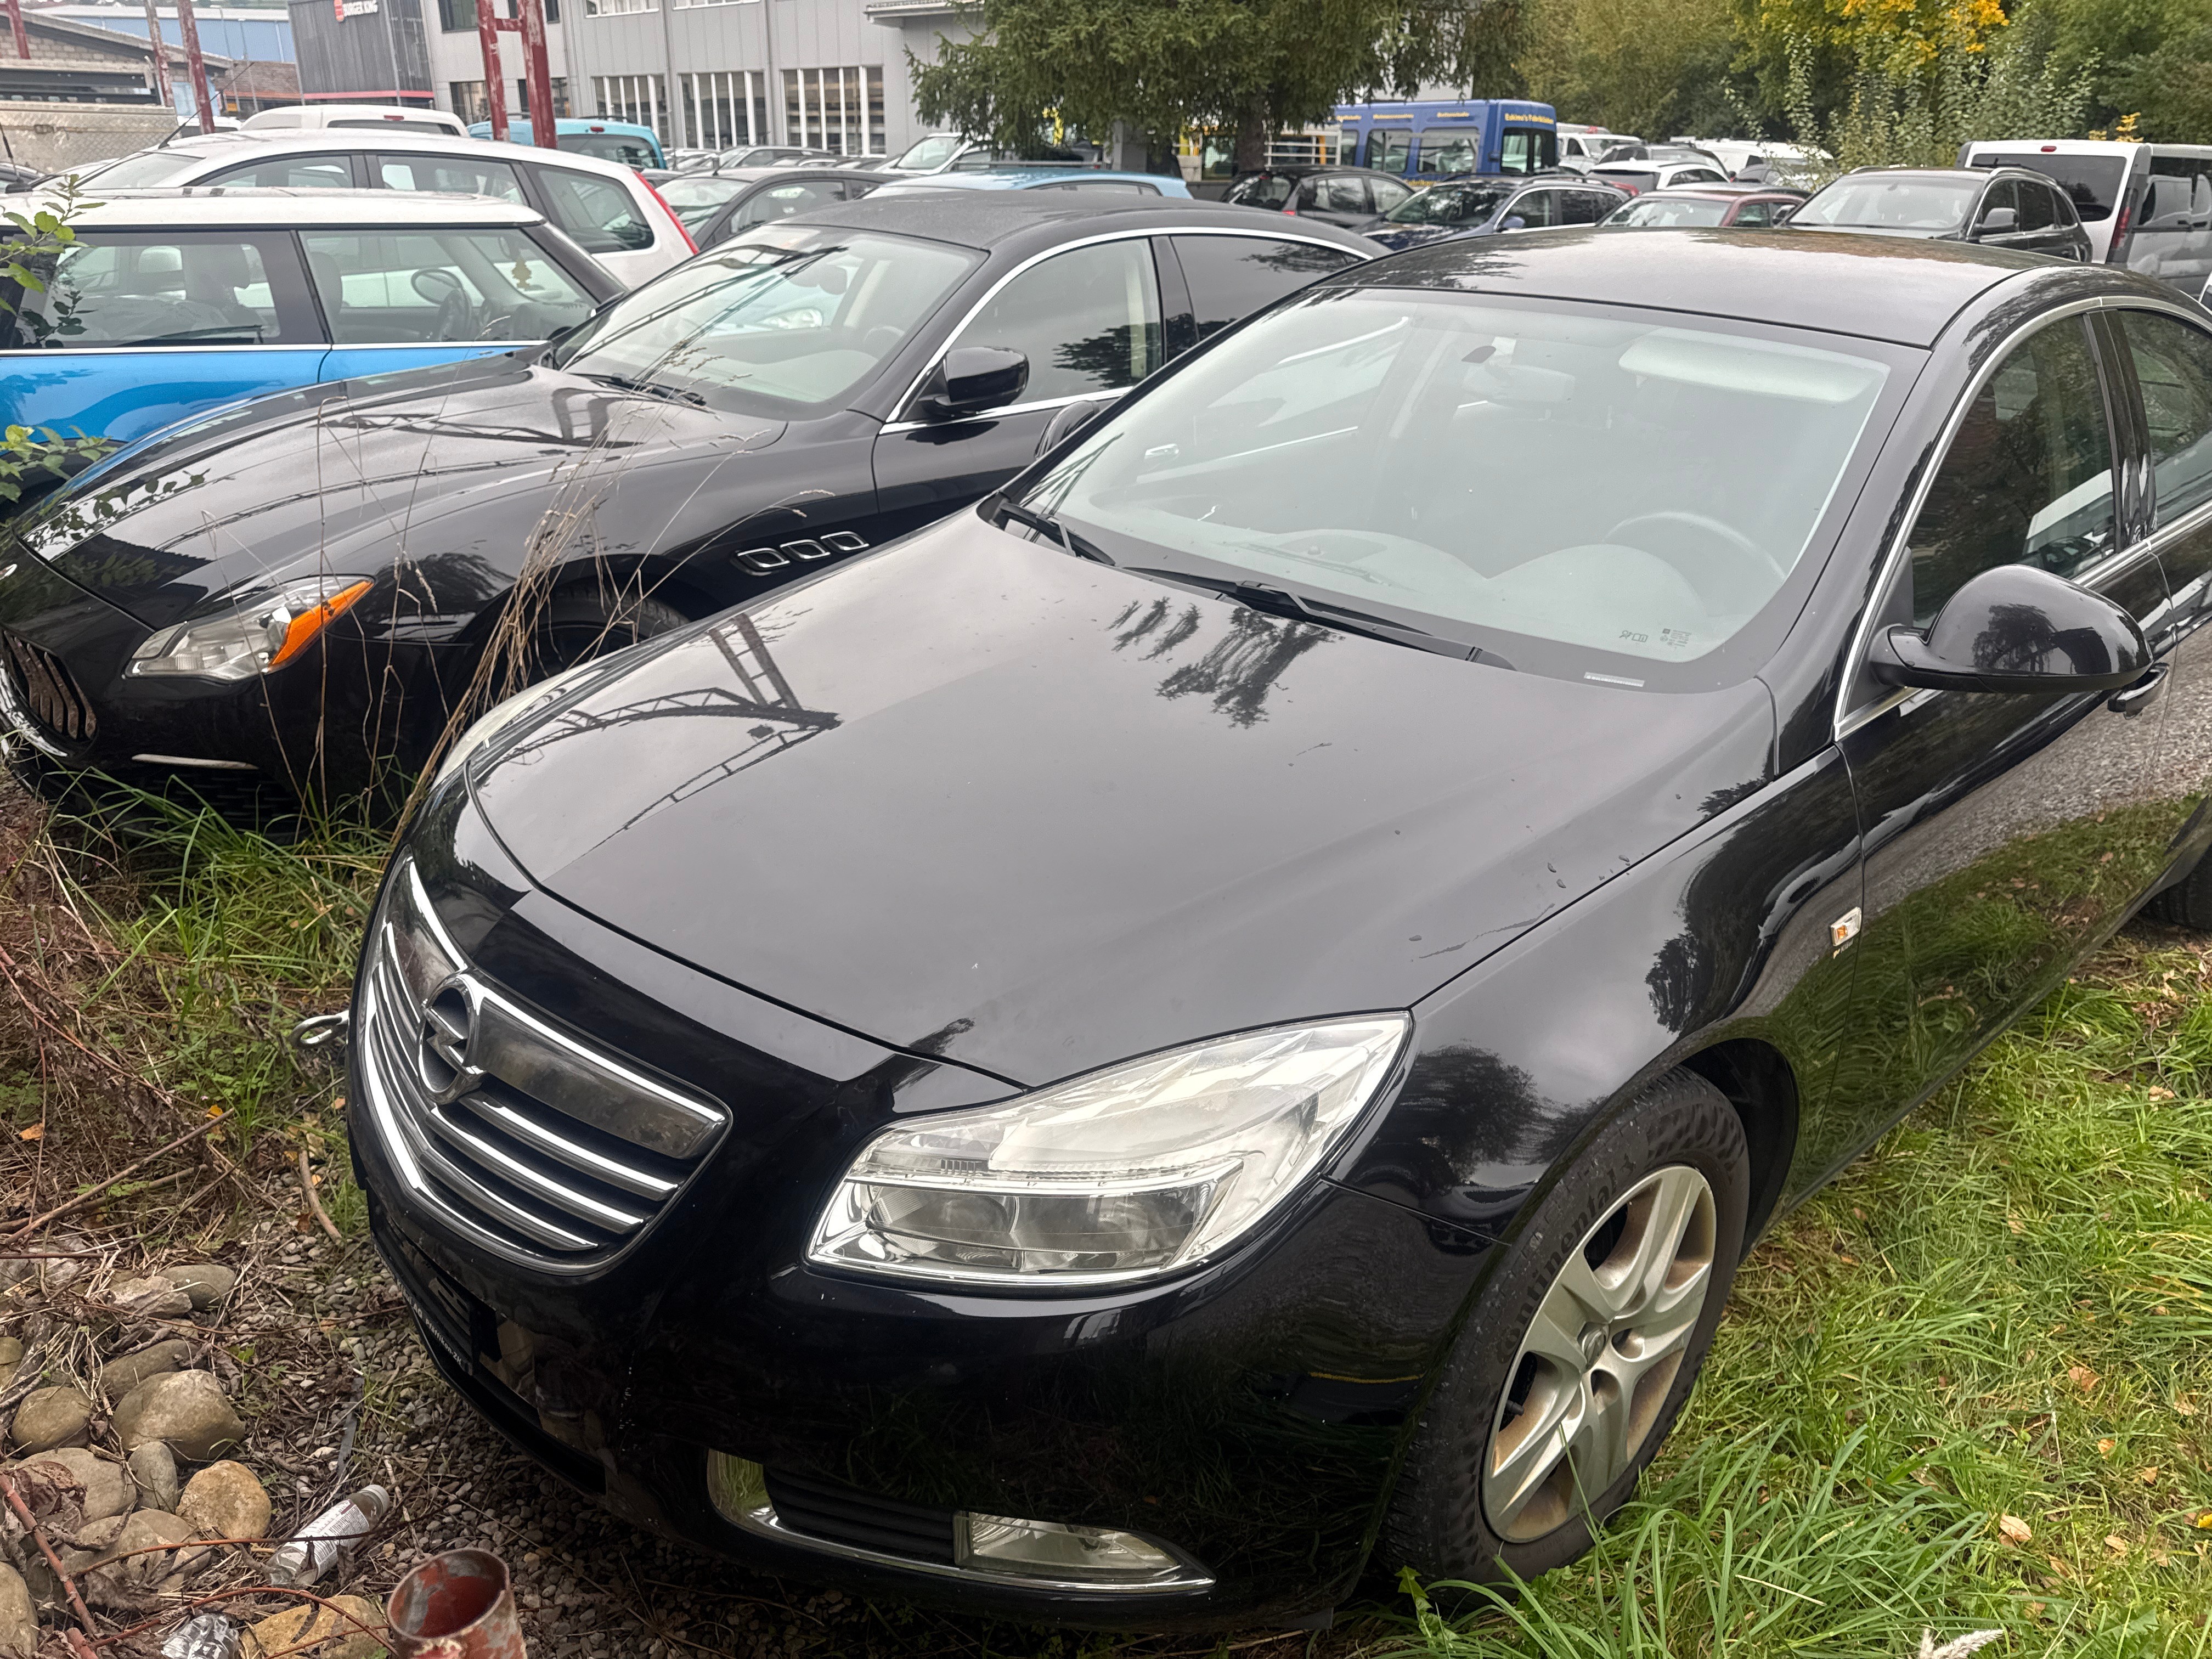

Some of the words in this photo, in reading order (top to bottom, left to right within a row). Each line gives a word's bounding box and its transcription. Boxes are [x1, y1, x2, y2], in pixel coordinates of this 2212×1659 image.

[363, 0, 378, 13] KING
[1497, 1168, 1617, 1364] Continental
[413, 1303, 422, 1319] AG
